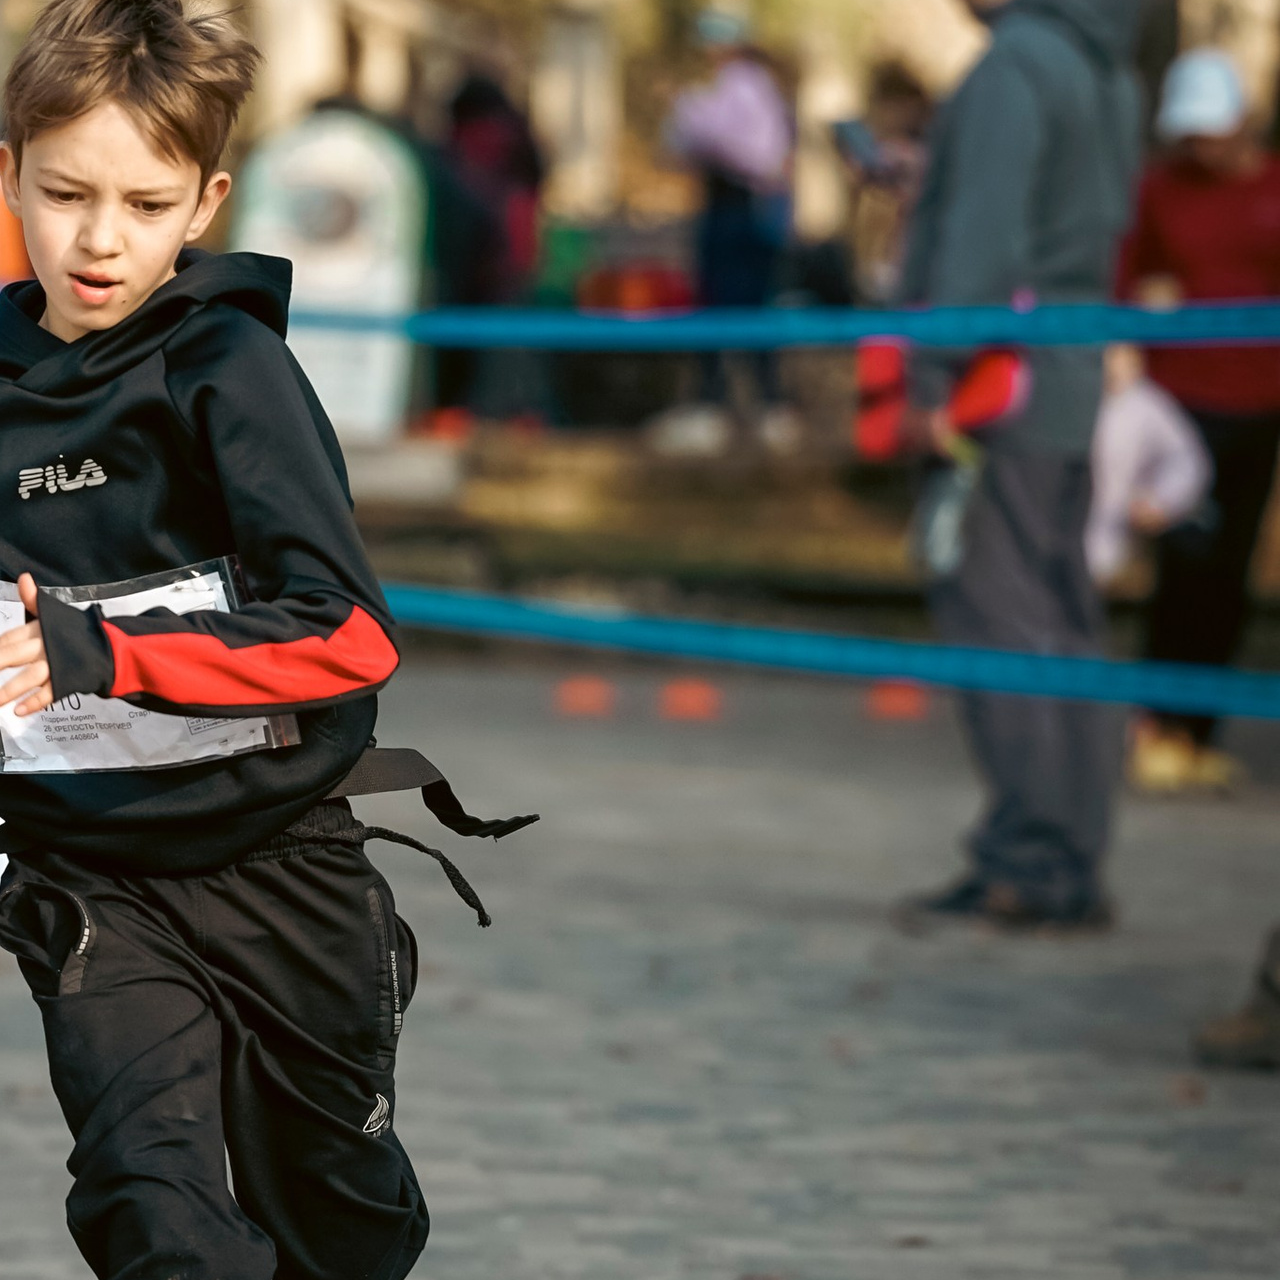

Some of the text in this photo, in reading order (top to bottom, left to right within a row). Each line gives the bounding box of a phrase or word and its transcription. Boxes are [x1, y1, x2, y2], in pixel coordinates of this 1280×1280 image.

[18, 459, 108, 499] FILA
[70, 713, 97, 722] Кирилл
[389, 950, 401, 1012] REACTION INCREASE
